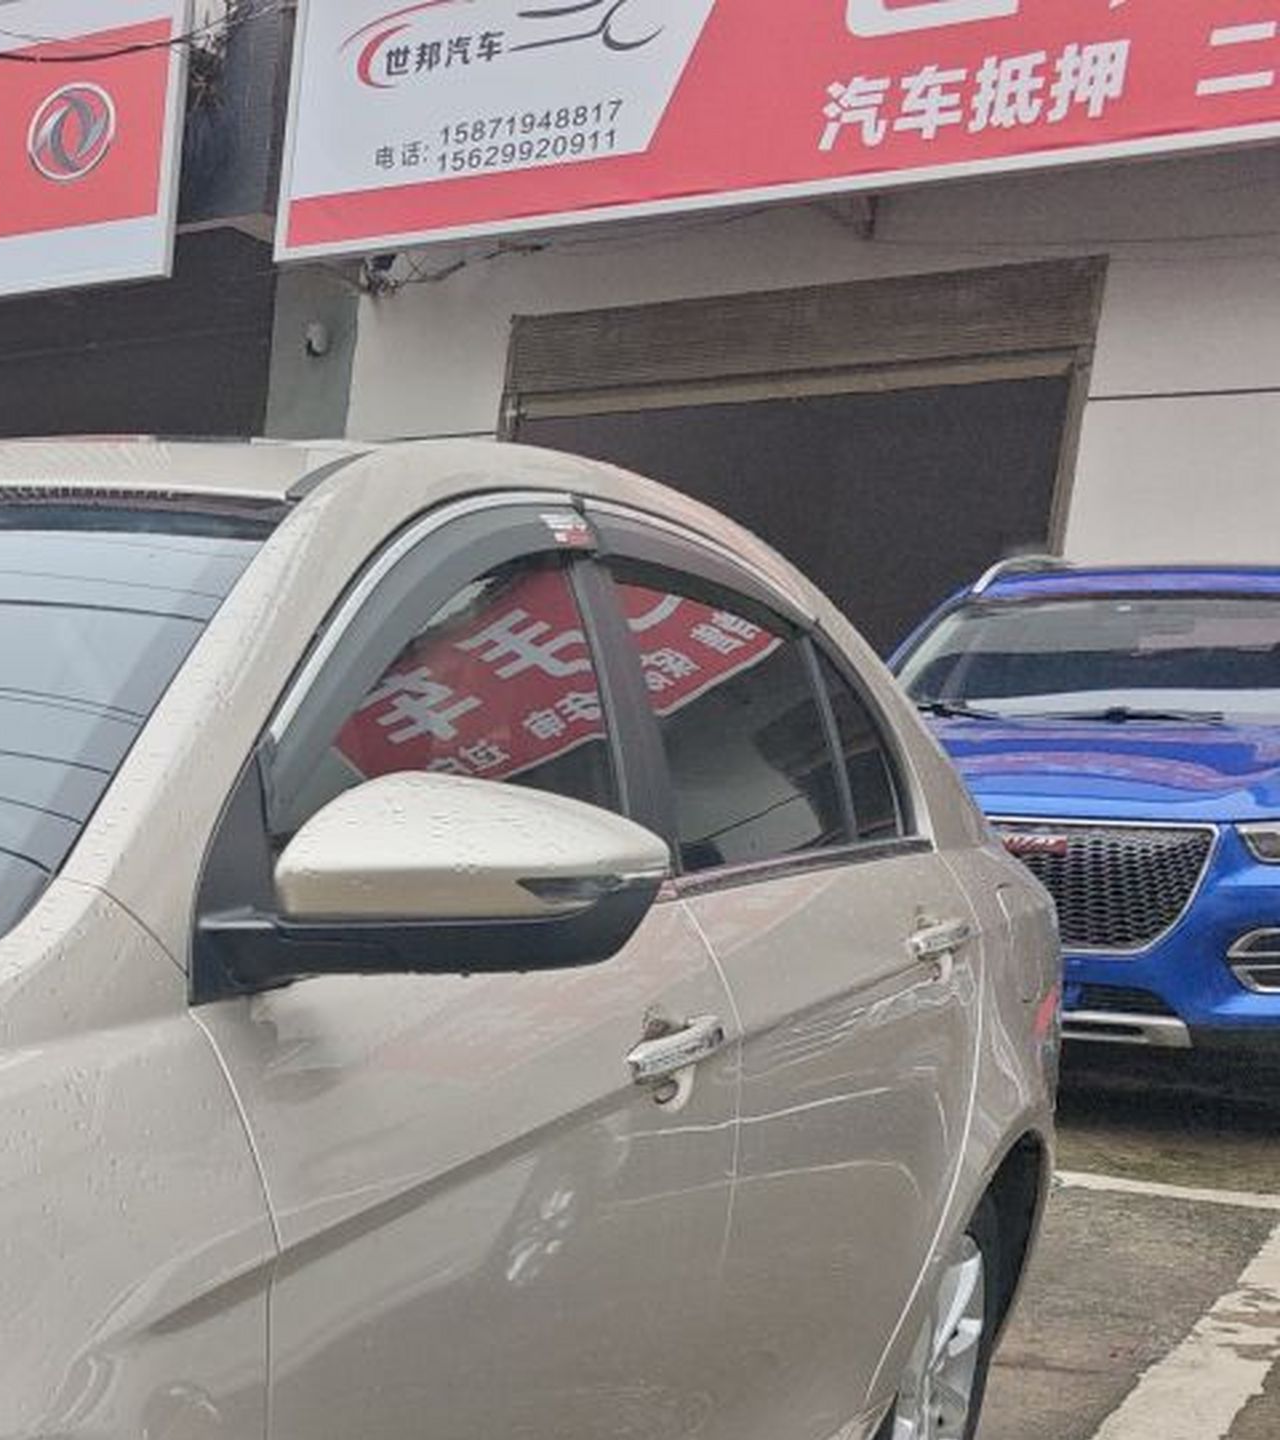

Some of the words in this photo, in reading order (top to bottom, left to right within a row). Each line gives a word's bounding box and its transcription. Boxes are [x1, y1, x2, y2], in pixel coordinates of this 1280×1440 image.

[385, 31, 505, 76] 世邦汽车
[818, 39, 1132, 151] 汽车抵押
[440, 99, 623, 146] 15871948817
[437, 128, 617, 172] 15629920911
